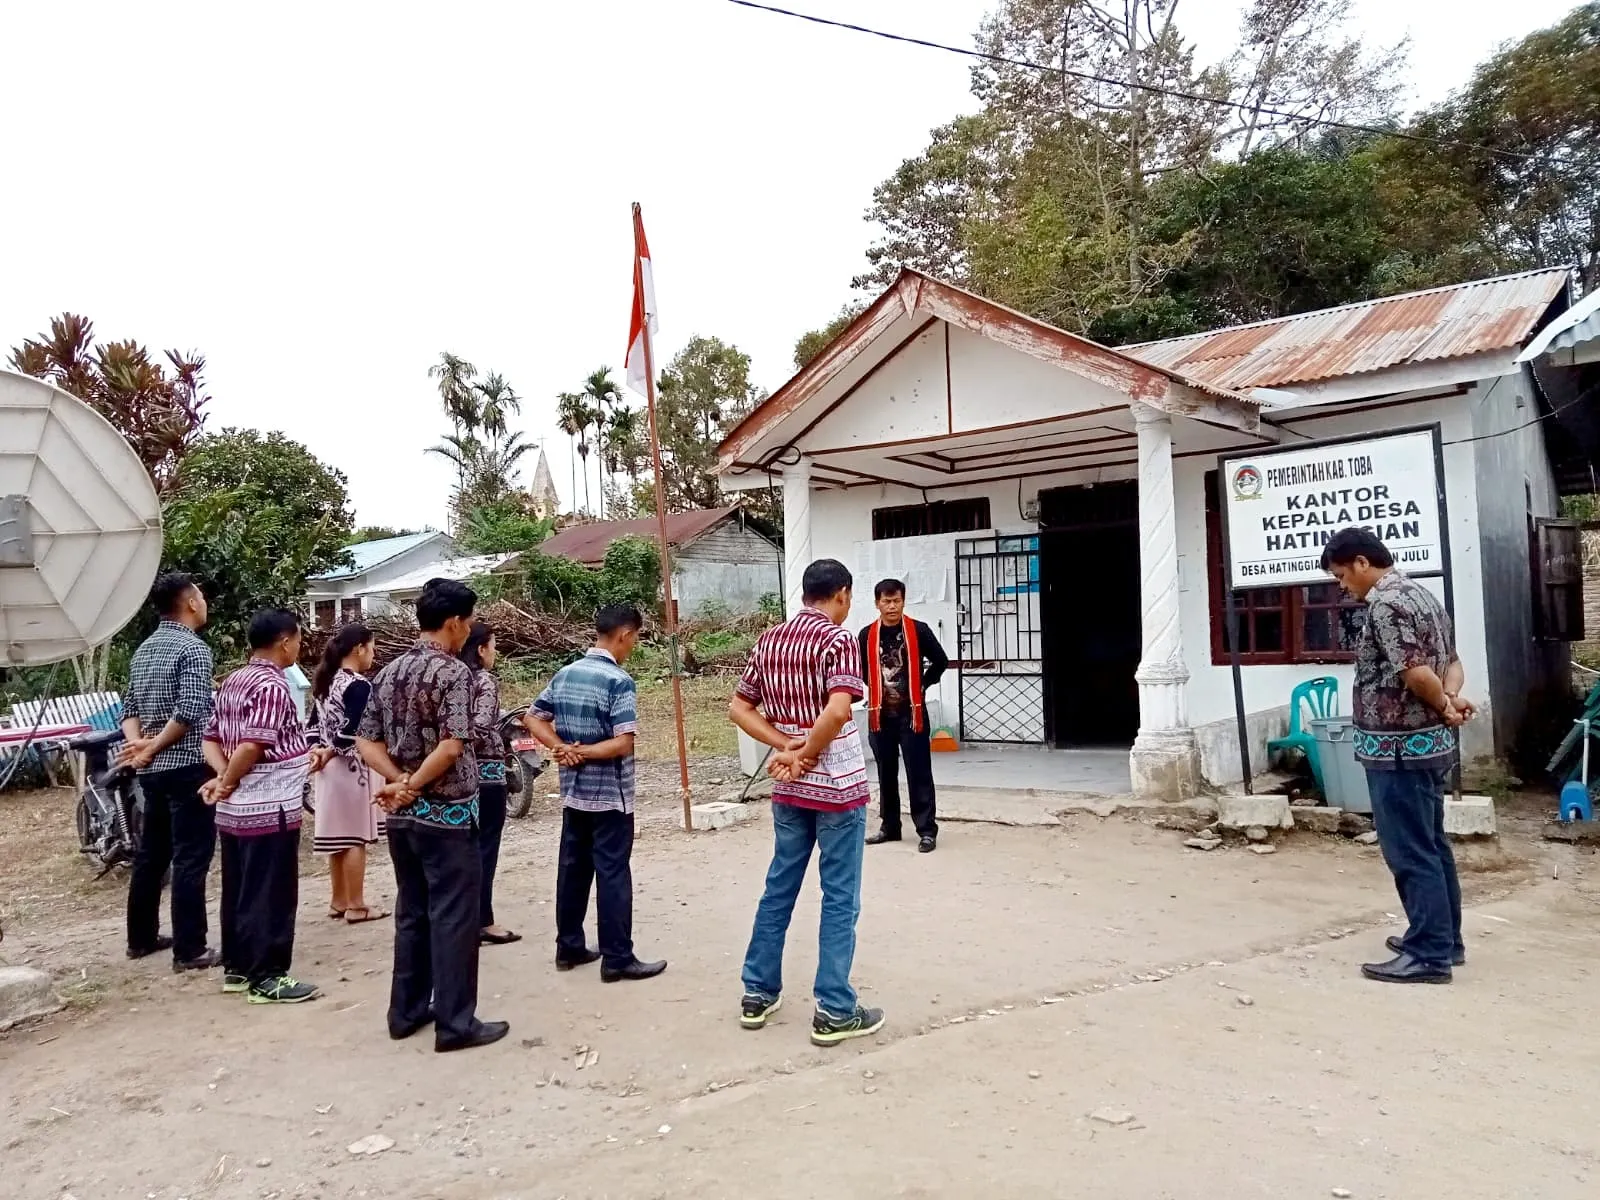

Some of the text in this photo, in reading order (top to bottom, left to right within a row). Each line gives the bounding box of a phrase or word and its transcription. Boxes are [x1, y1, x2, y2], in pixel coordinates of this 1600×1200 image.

[1267, 456, 1373, 488] PEMERINTAH KAB. TOBA
[1287, 485, 1389, 510] KANTOR
[1262, 500, 1421, 531] KEPALA DESA
[1266, 521, 1419, 551] HATINIAN
[1242, 560, 1321, 576] DESA HATINGGIA
[1402, 549, 1429, 562] JULU
